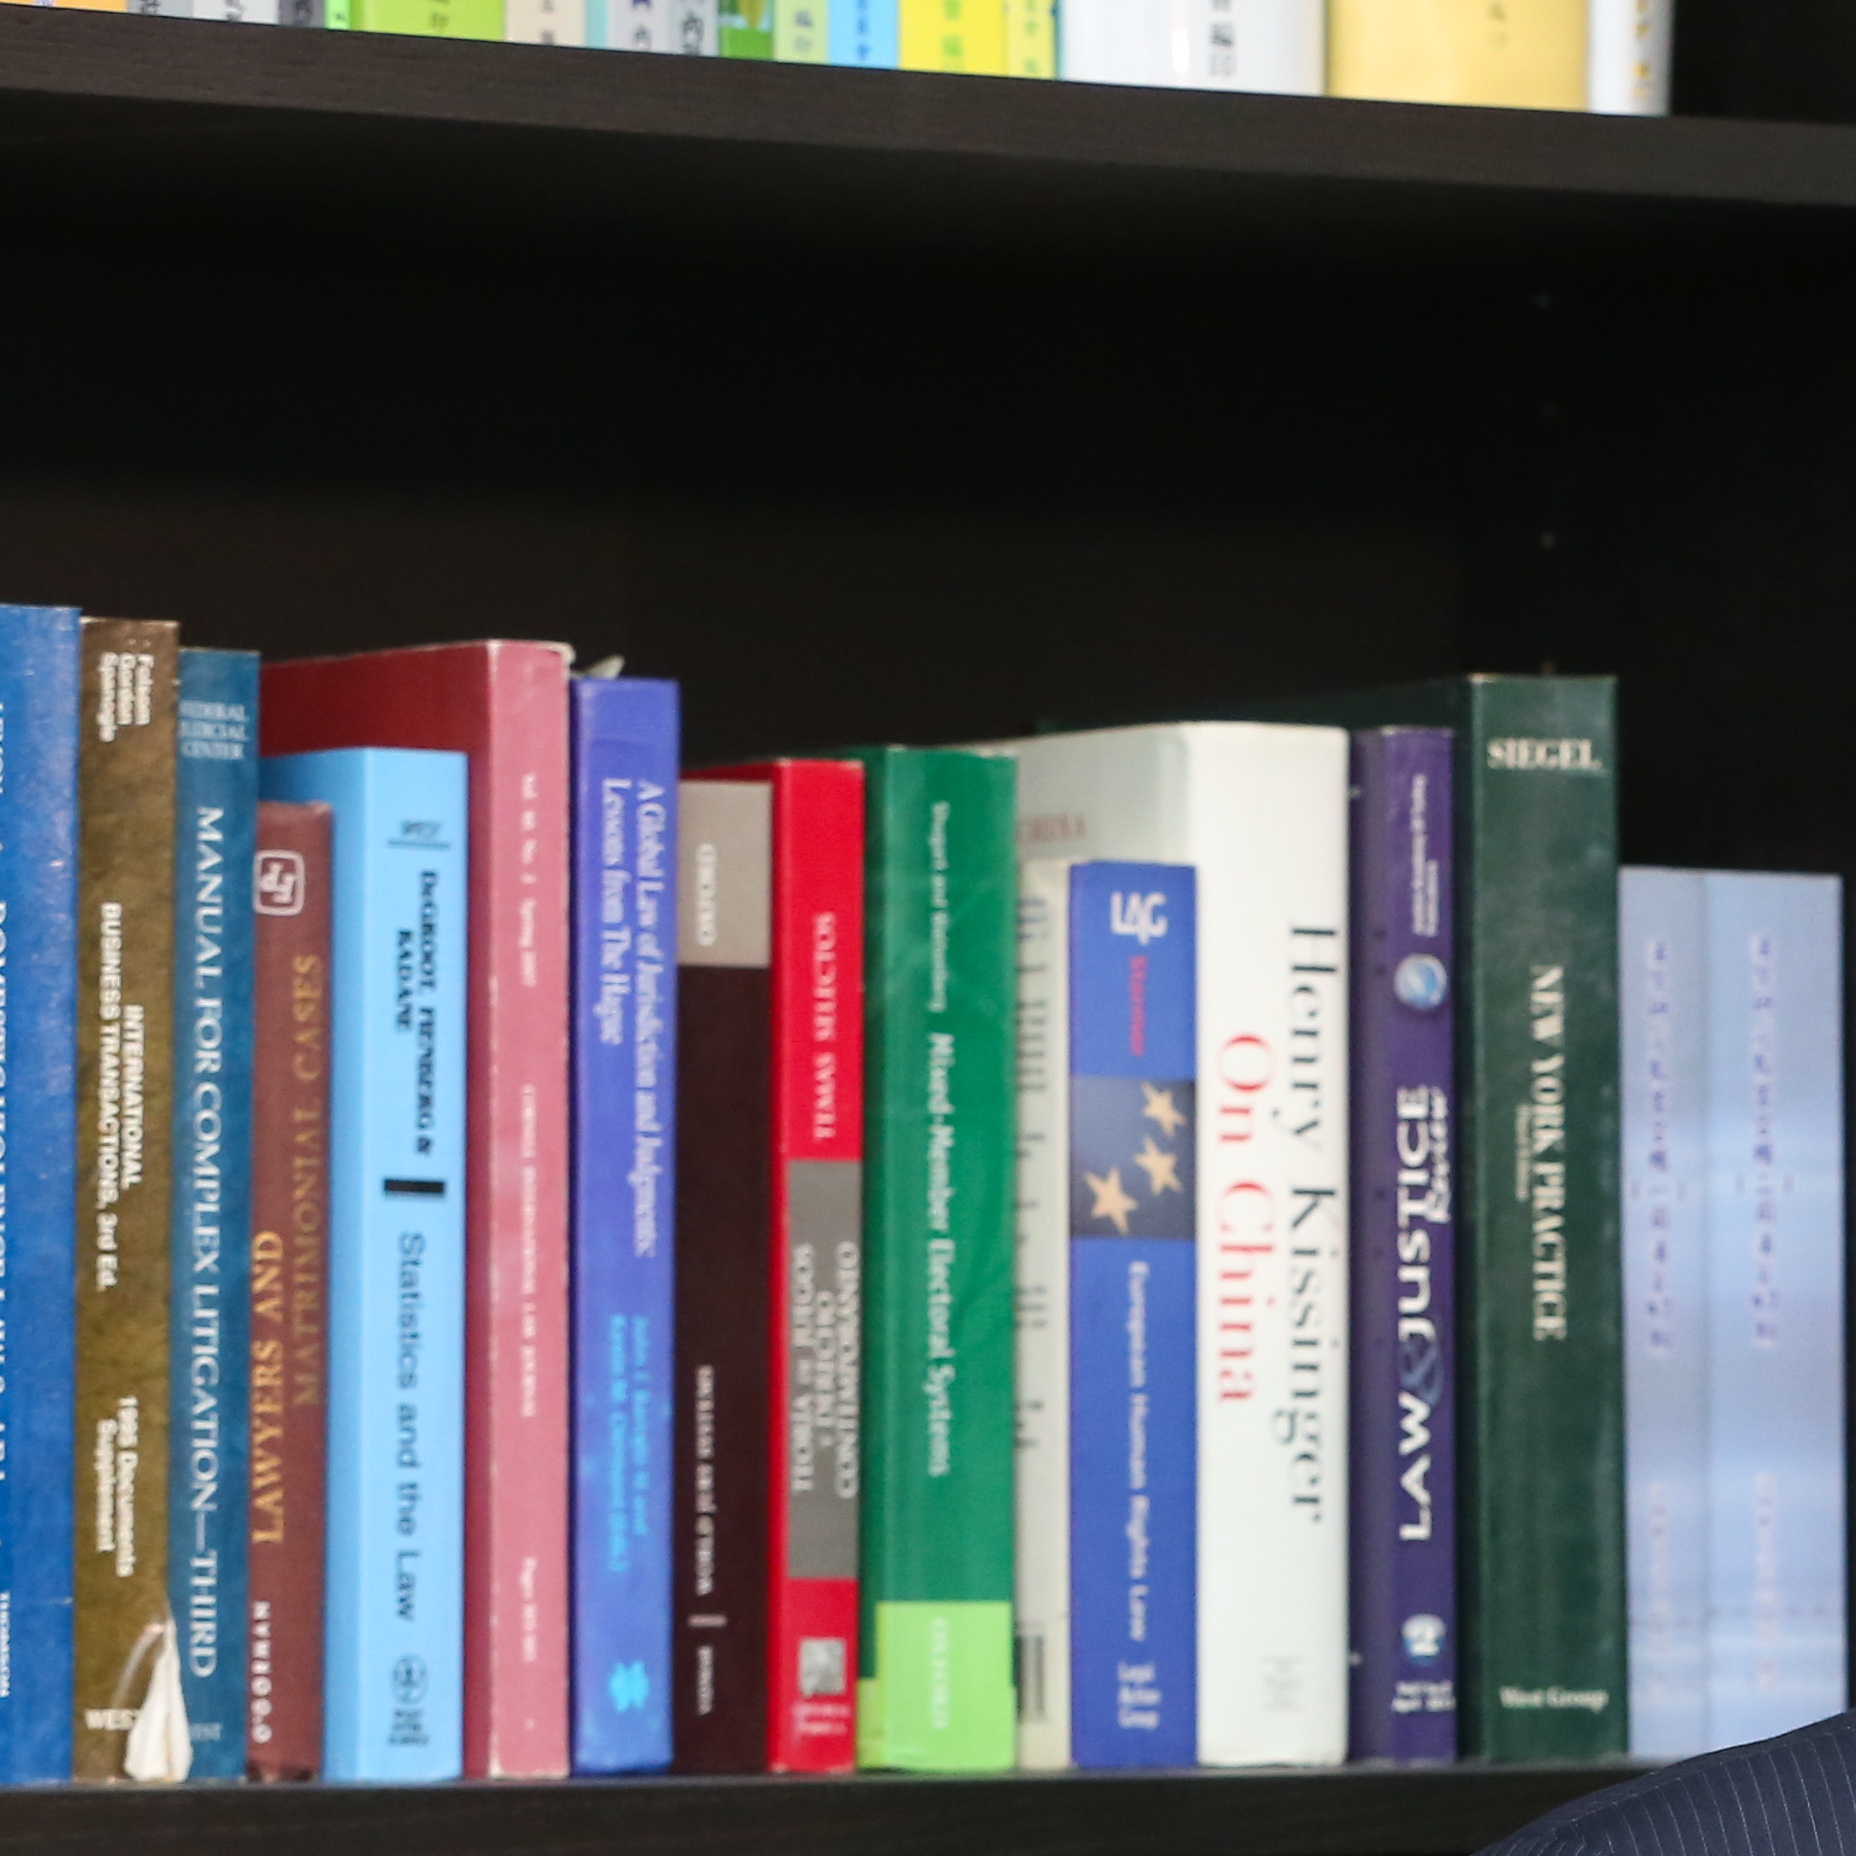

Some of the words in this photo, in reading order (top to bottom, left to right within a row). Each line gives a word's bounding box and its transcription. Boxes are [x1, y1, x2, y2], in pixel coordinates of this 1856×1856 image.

[602, 778, 632, 865] Lessons
[638, 781, 665, 799] A
[638, 804, 664, 876] Global
[194, 806, 224, 987] MANUAL
[600, 869, 631, 922] from
[600, 928, 630, 968] The
[636, 931, 661, 956] of
[637, 881, 662, 926] Law
[98, 902, 122, 1018] BUSINESS
[593, 972, 628, 1045] Hague
[1530, 964, 1568, 1046] NEW
[193, 996, 222, 1072] FOR
[292, 955, 322, 1082] CASES
[634, 960, 661, 1086] Jurisdiction
[1271, 927, 1337, 1152] Henry
[97, 1022, 121, 1211] TRANSACTIONS,
[120, 1004, 144, 1190] INTERNATIONAL
[633, 1090, 659, 1131] and
[927, 1031, 956, 1229] Mixed-Member
[1217, 1033, 1278, 1143] On
[1531, 1053, 1567, 1154] YORK
[191, 1081, 221, 1274] COMPLEX
[1396, 1085, 1436, 1341] JUSTICE
[253, 1230, 285, 1318] AND
[293, 1099, 322, 1406] MATRIMONIAL
[926, 1239, 955, 1358] Electoral
[1217, 1181, 1278, 1403] China
[1531, 1161, 1567, 1341] PRACTICE
[397, 1231, 426, 1390] Statistics
[1127, 1260, 1151, 1387] European
[1271, 1187, 1338, 1521] Kissinger
[252, 1339, 285, 1544] LAWYERS
[396, 1403, 424, 1468] and
[924, 1363, 955, 1478] Systems
[1127, 1391, 1150, 1489] Human
[1398, 1391, 1432, 1541] LAW
[95, 1419, 117, 1552] Supplement
[114, 1450, 137, 1578] Documents
[395, 1481, 423, 1537] the
[1126, 1494, 1151, 1579] Rights
[394, 1550, 423, 1620] Law
[1128, 1584, 1150, 1642] Law
[1500, 1684, 1541, 1709] West
[1544, 1686, 1609, 1713] Group
